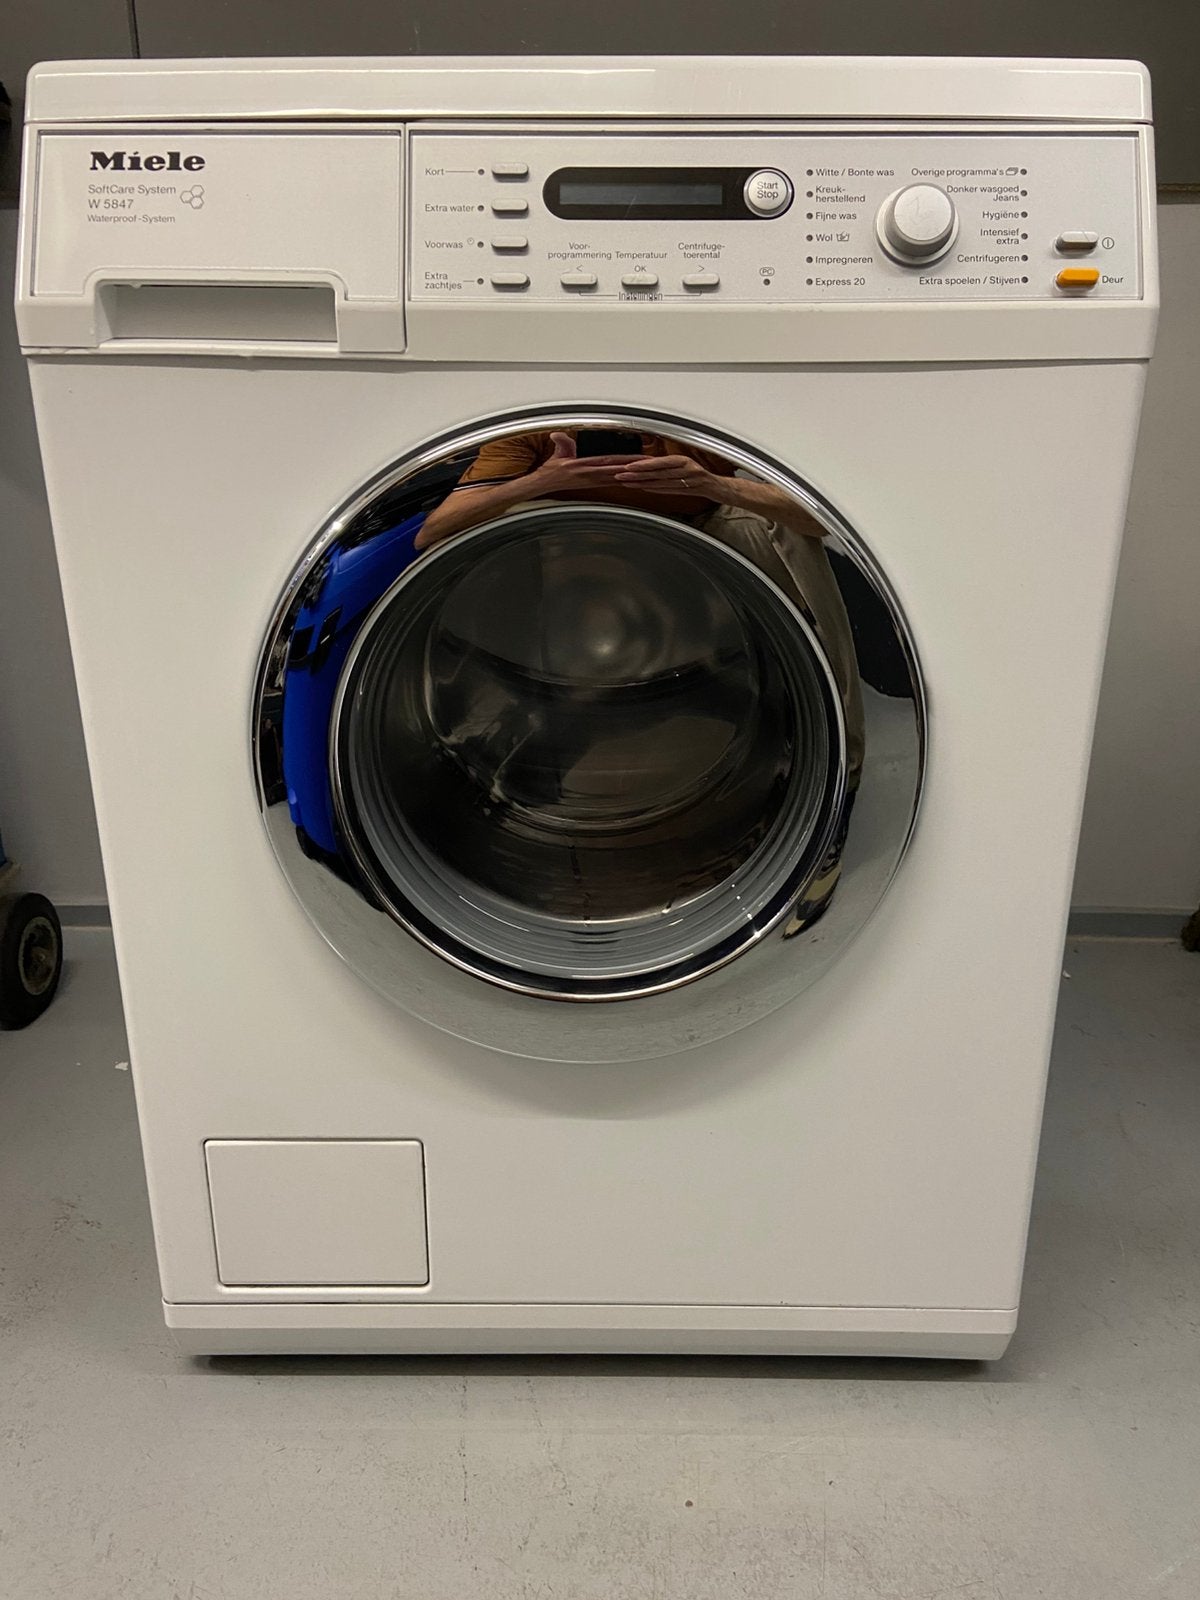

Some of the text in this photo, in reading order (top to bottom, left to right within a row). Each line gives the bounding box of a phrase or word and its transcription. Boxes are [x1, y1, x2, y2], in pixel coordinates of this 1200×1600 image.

[90, 151, 206, 171] Miele
[425, 168, 444, 176] Kort
[816, 168, 839, 176] Witte
[848, 168, 874, 176] Bonte
[911, 168, 1004, 177] Overige programma's
[88, 184, 176, 195] SoftCare System
[757, 181, 778, 190] Start
[816, 185, 846, 193] Kreuk-
[947, 185, 1019, 195] Donker wasgoed
[757, 190, 779, 200] Stop
[816, 194, 866, 203] herstellend
[993, 194, 1019, 202] Jeans
[88, 199, 134, 209] W 5847
[425, 204, 475, 212] Extra water
[816, 212, 837, 221] Fijne
[982, 210, 1020, 221] Hygiëne
[980, 228, 1020, 236] Intensief
[816, 233, 833, 242] Wol
[996, 237, 1020, 245] extra
[424, 240, 463, 249] Voorwas
[569, 242, 591, 250] Voor-
[678, 242, 725, 251] Centrifuge-
[548, 251, 612, 260] programmering
[615, 251, 668, 260] Temperatuur
[683, 251, 721, 259] toerental
[957, 254, 1020, 264] Centrifugeren
[816, 256, 873, 265] Impregneren
[425, 272, 448, 280] Extra
[1102, 276, 1124, 284] Deur
[816, 277, 866, 287] Express 20
[919, 276, 943, 285] Extra
[945, 276, 981, 286] spoelen
[989, 276, 1020, 286] Stijven
[424, 281, 462, 291] zachtjes
